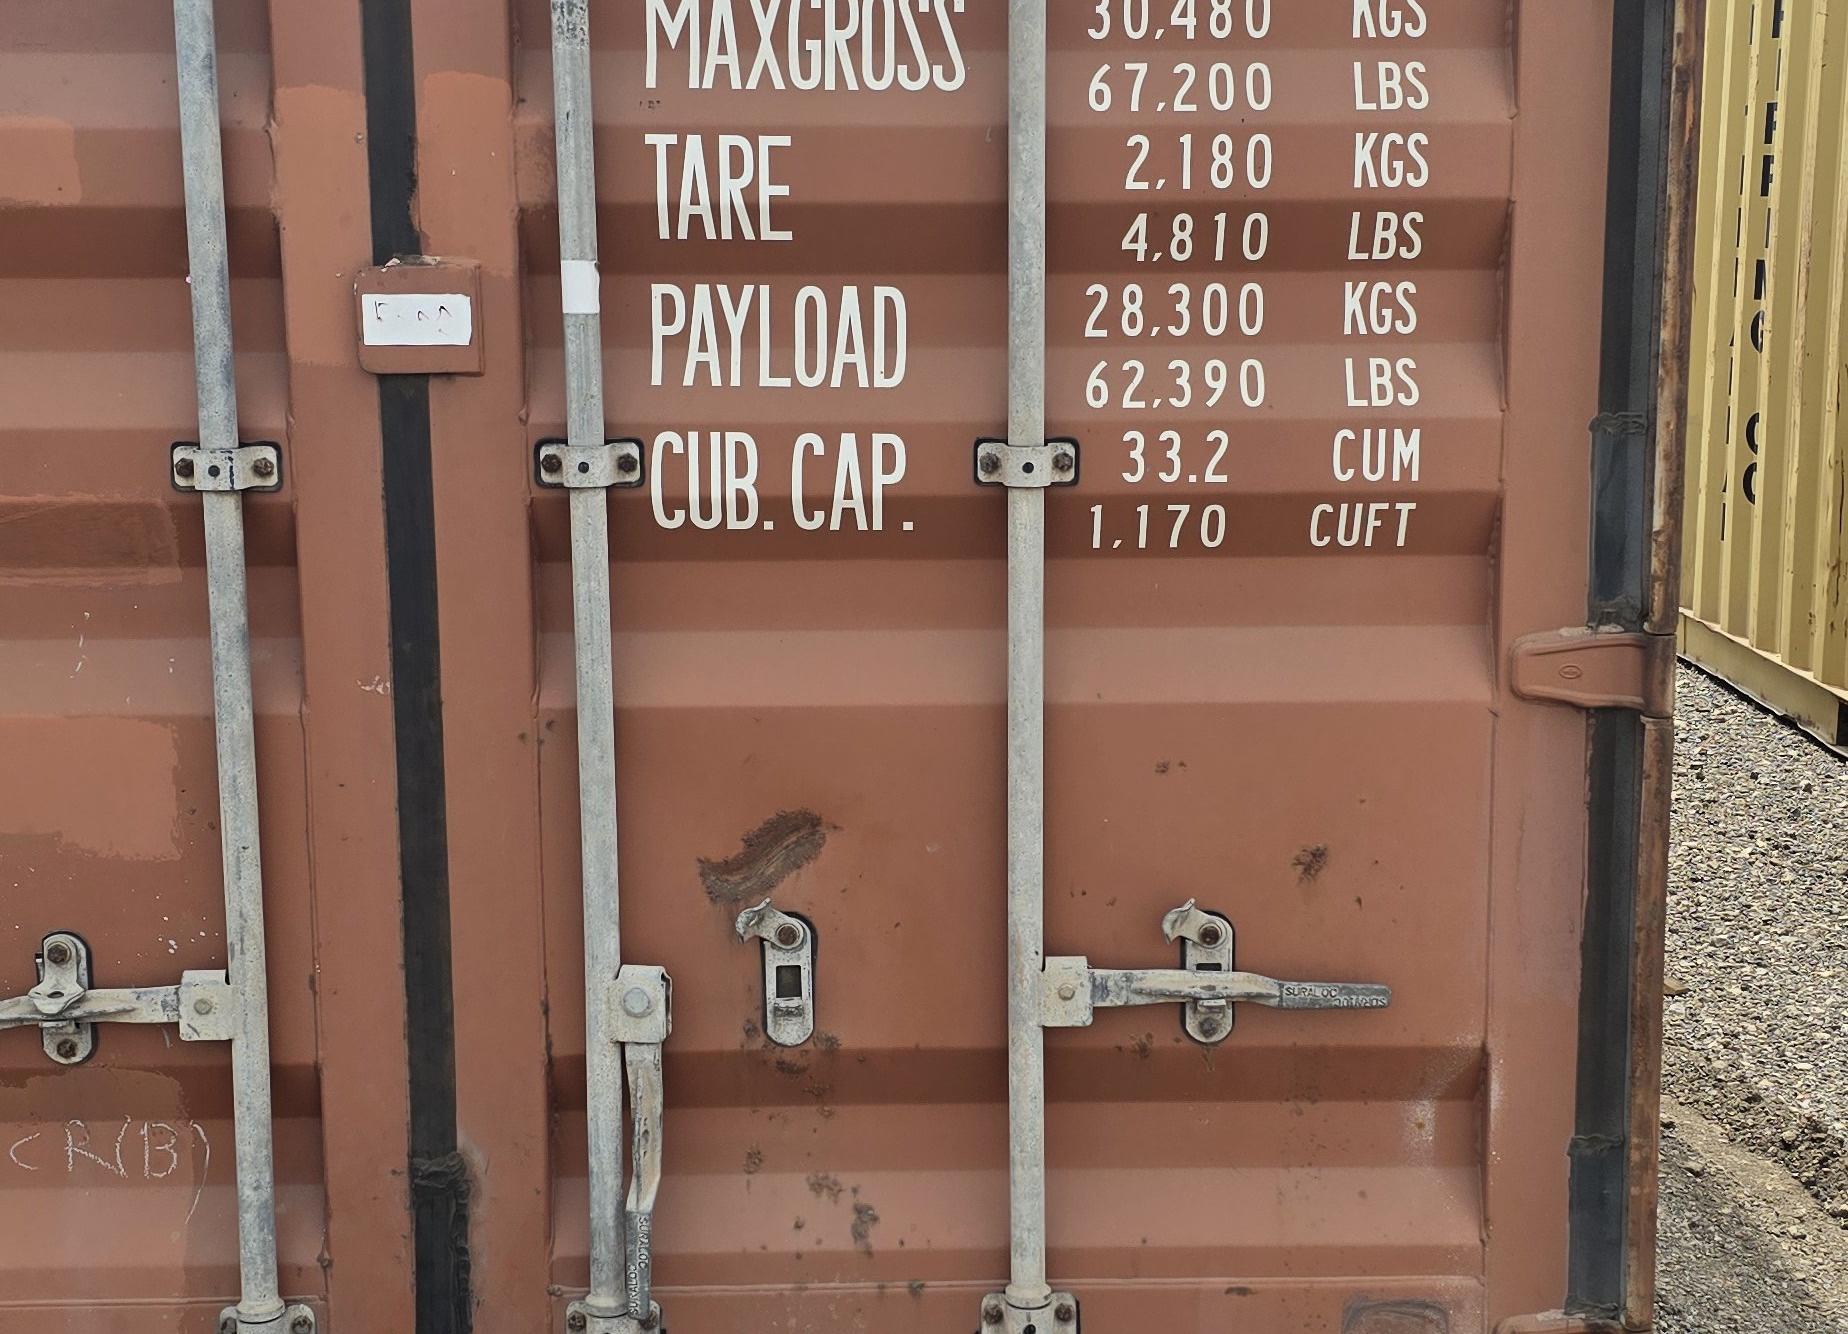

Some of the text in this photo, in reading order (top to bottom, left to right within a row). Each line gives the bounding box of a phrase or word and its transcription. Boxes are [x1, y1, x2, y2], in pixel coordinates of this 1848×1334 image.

[1088, 62, 1429, 112] 67,200 LBS
[645, 133, 1428, 240] TARE 2,180 KGS
[1122, 212, 1423, 262] 4,810 LBS
[651, 281, 1417, 387] PAYLOAD 28,300 KGS
[1086, 358, 1419, 409] 62,390 LBS
[651, 429, 1420, 531] CUB. CAP. 33.2 CUM
[1090, 503, 1416, 549] 1,170 CUFT
